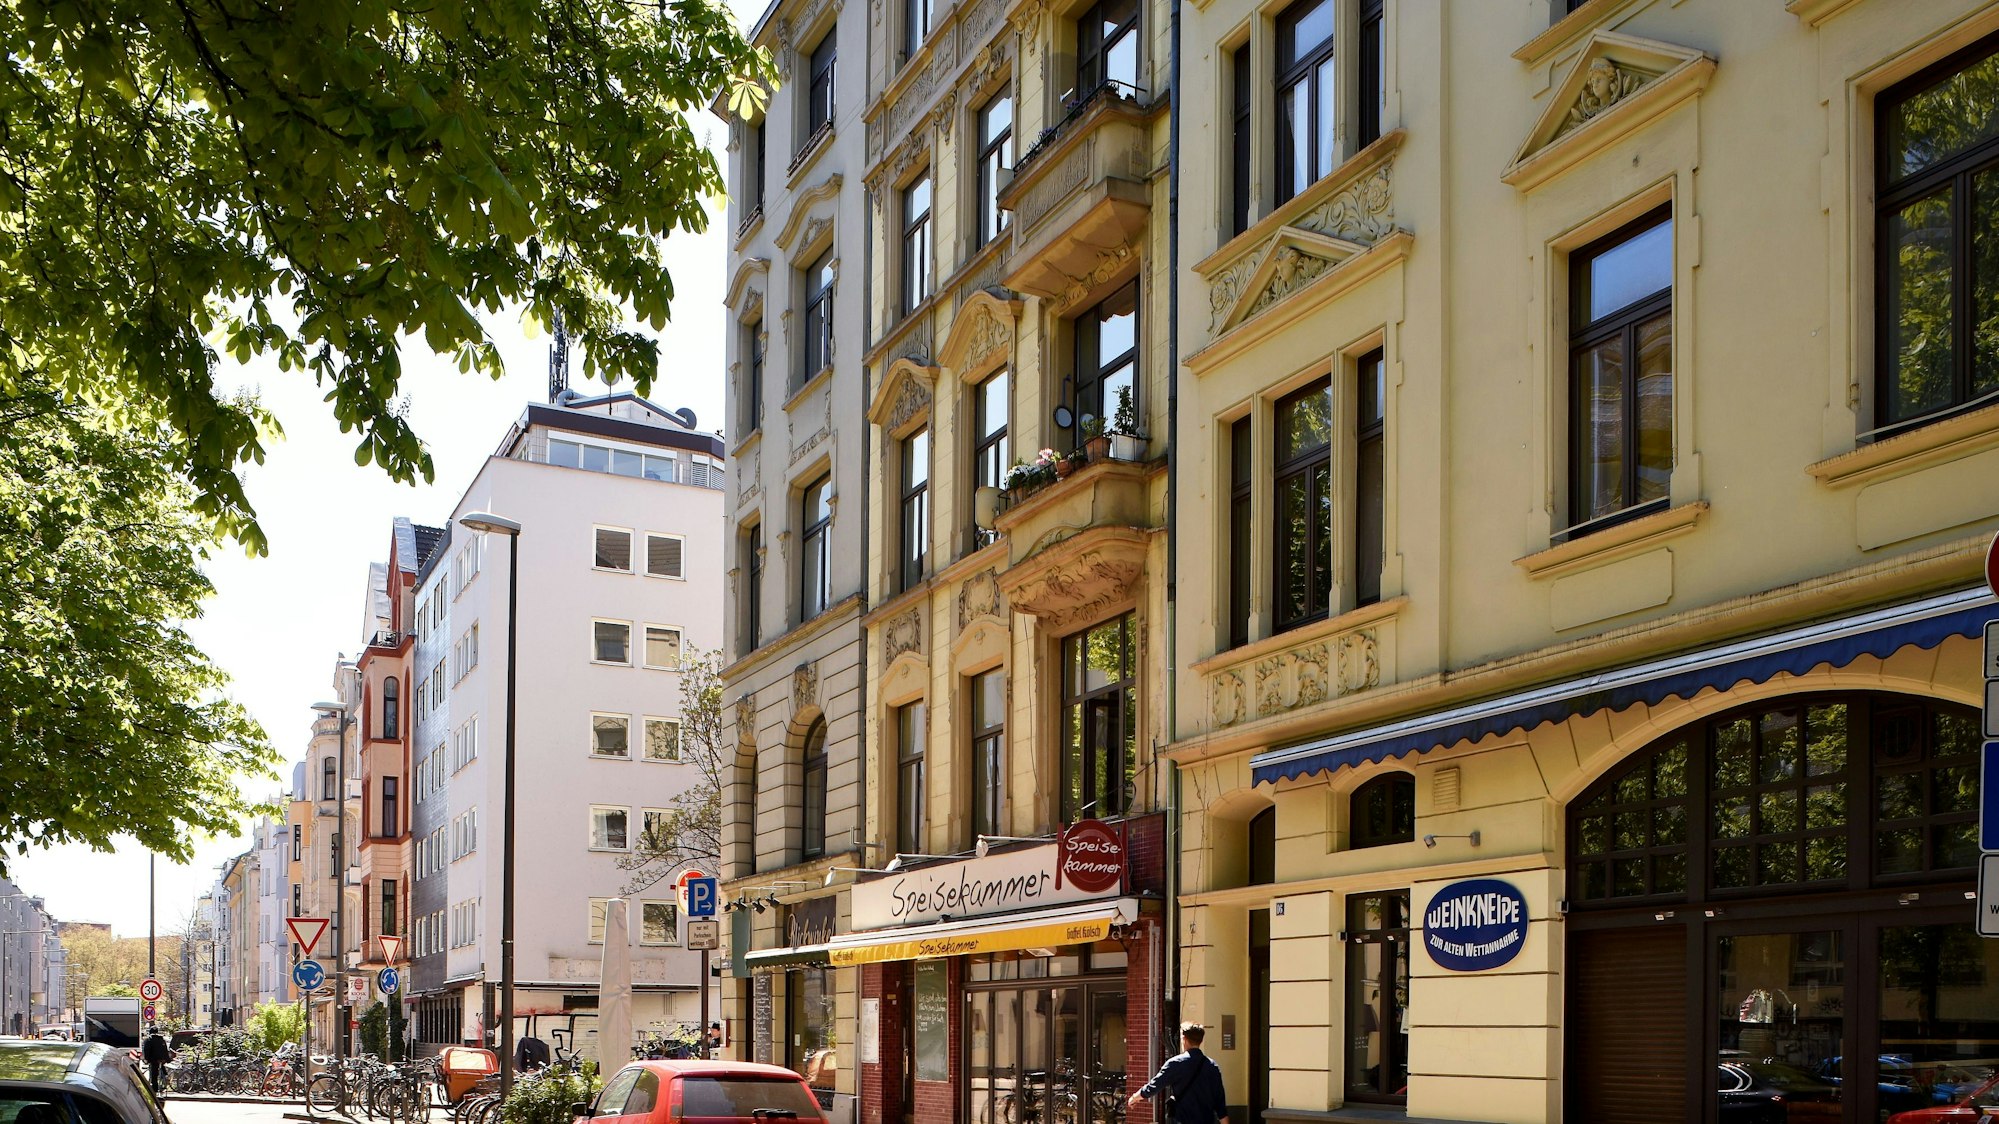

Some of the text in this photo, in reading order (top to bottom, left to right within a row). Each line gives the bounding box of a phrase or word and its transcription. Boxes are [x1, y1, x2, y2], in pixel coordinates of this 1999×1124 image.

[1066, 836, 1122, 855] Speise-
[1063, 855, 1122, 875] kammer
[694, 883, 710, 912] P
[891, 865, 1051, 923] Speisekammer
[1428, 892, 1520, 930] WEINKNEIPE
[787, 913, 836, 948] Blickwinkel
[1430, 929, 1520, 958] ZUR ALTEN WETTANNAHME
[918, 937, 980, 956] Speisekammer
[144, 985, 158, 996] 30
